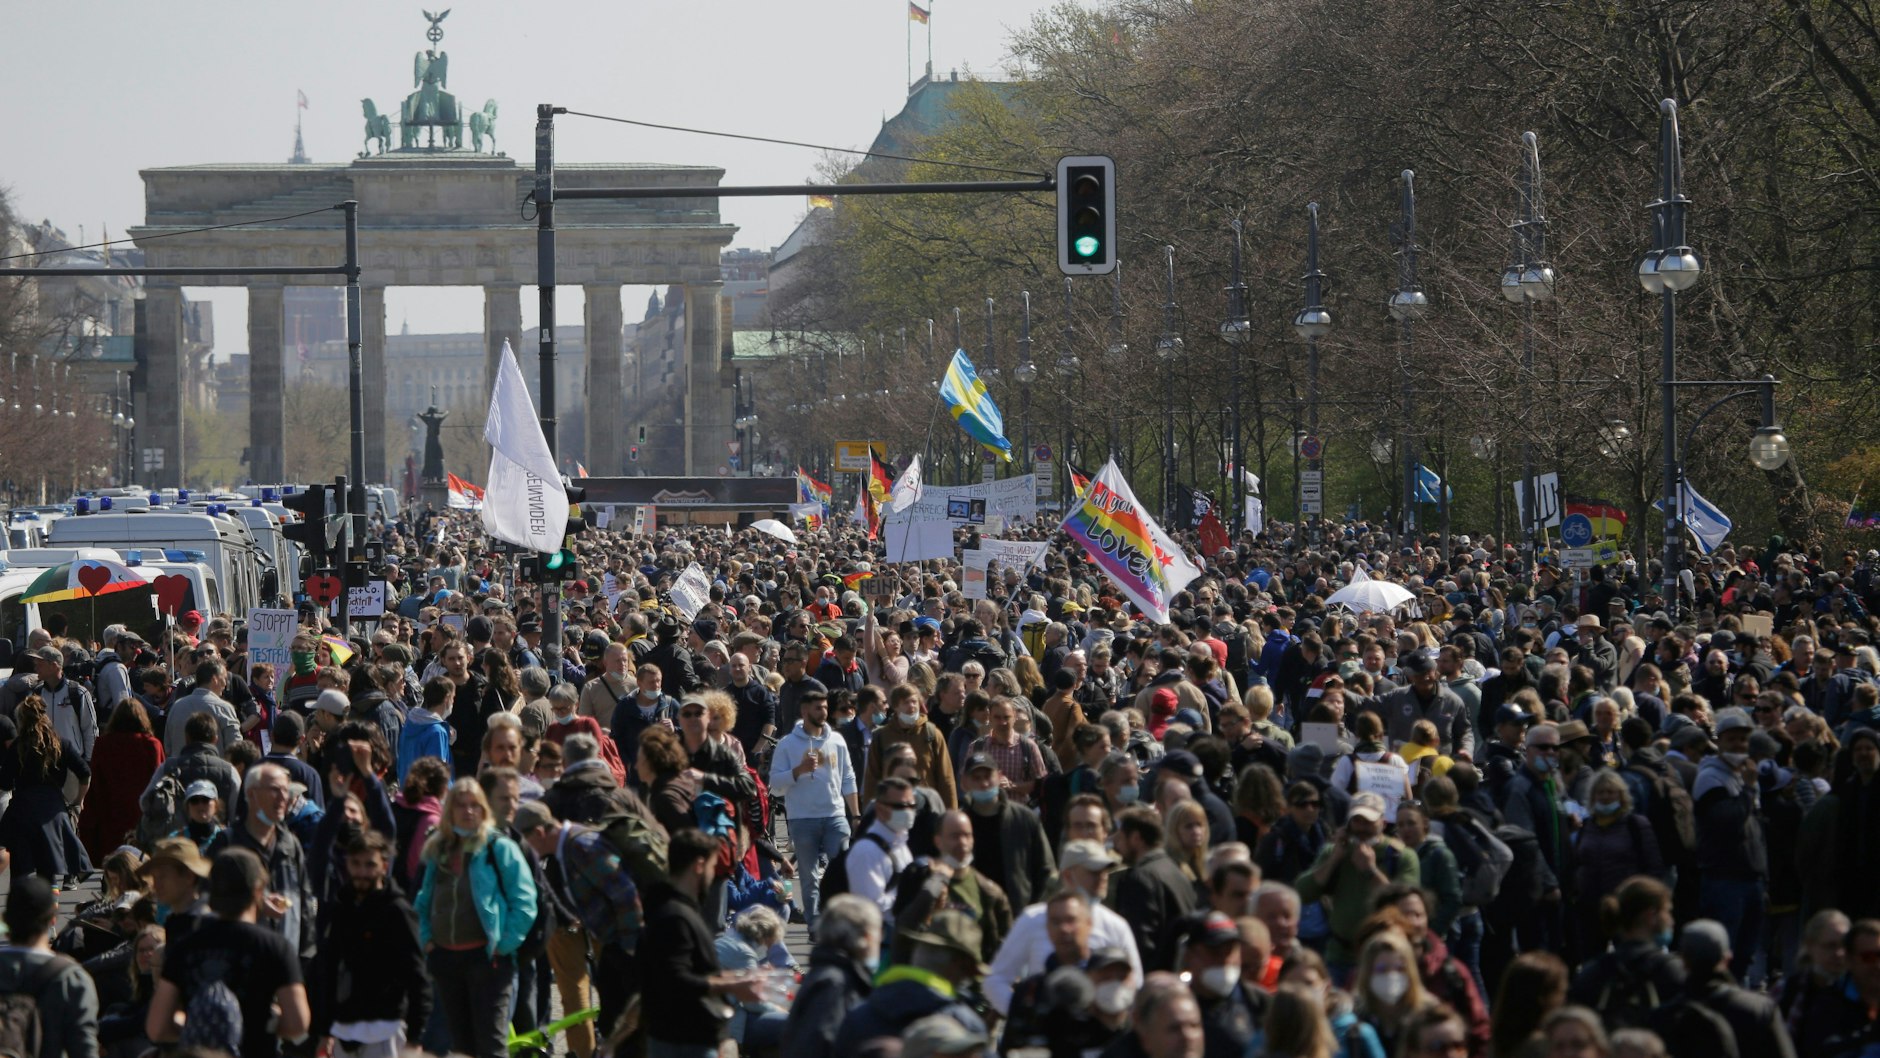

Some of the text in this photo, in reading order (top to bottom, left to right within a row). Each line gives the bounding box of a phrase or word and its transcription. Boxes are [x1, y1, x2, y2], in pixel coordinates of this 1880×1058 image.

[968, 483, 992, 497] TARNT
[1092, 490, 1134, 514] all you
[1085, 515, 1154, 583] LOVE!
[253, 612, 295, 633] STOPPT
